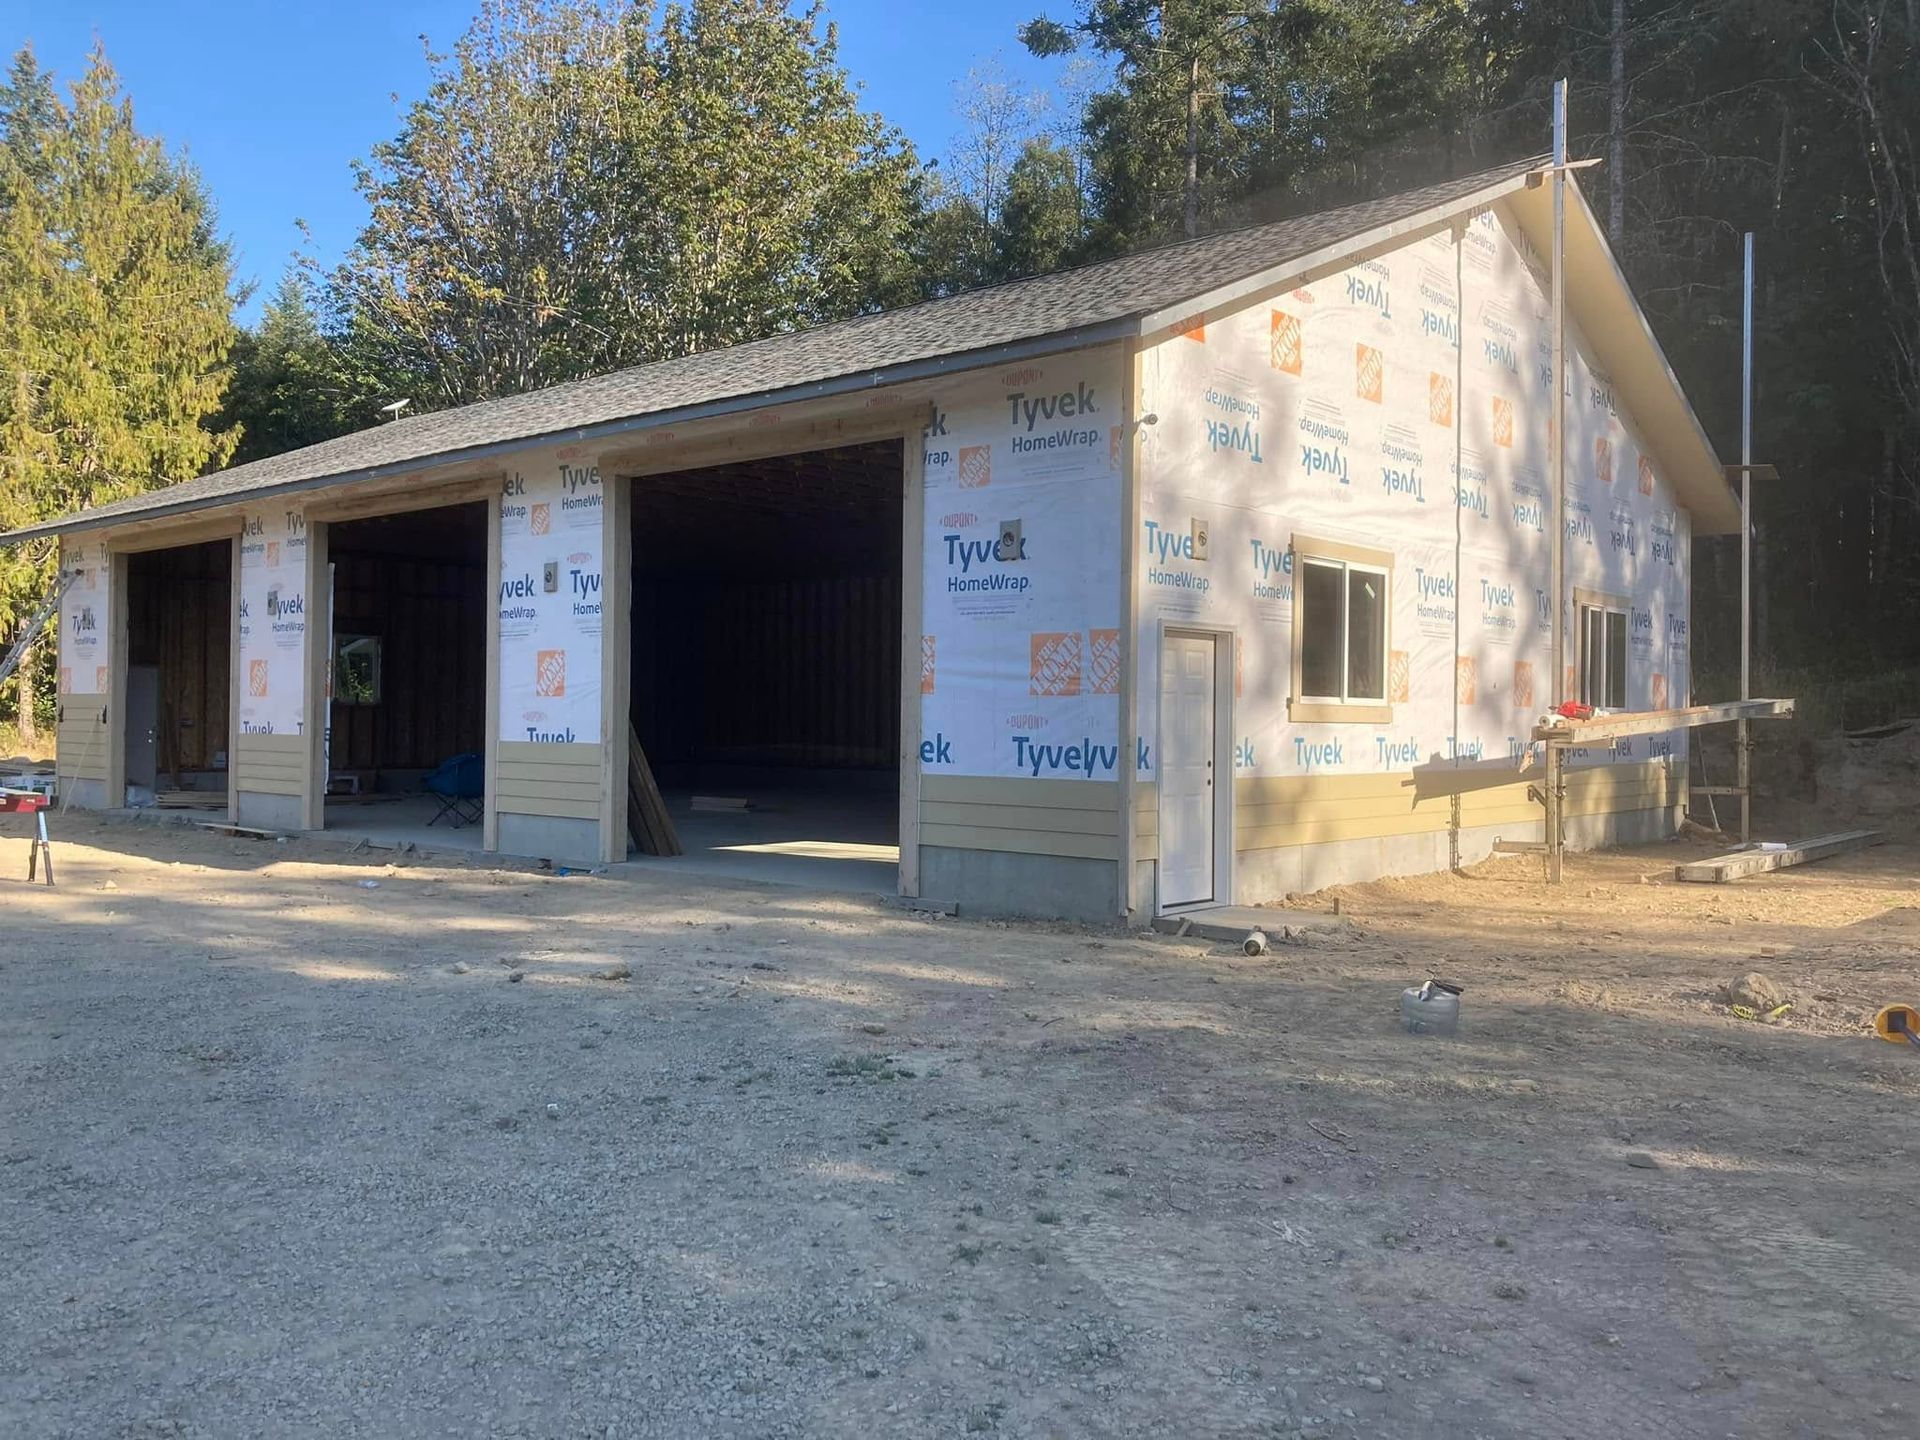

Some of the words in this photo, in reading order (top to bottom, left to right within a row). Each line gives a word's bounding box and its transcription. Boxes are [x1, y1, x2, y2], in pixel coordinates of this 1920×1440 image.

[1346, 275, 1391, 319] Tyvek
[1421, 308, 1459, 348] Tyvek
[1484, 339, 1518, 375] Tyvek
[1007, 381, 1095, 432] Tyvek
[1204, 386, 1260, 420] HomeWrap
[1206, 419, 1263, 463] Tyvek
[1299, 415, 1349, 446] HomeWrap
[1301, 445, 1350, 485] Tyvek
[1382, 466, 1425, 503] Tyvek
[1512, 503, 1544, 532] Tyvek
[1564, 515, 1592, 545] Tyvek
[1145, 520, 1192, 564] Tyve
[1610, 529, 1635, 556] Tyvek
[1651, 541, 1674, 566] Tyvek
[1251, 539, 1291, 579] Tyve
[1149, 567, 1208, 591] HomeWrap
[1415, 568, 1455, 601] Tyvek
[1481, 579, 1515, 610] Tyvek
[276, 594, 303, 620] yvek
[1631, 607, 1653, 633] Tyvek
[1295, 737, 1343, 772] Tyvek
[1376, 737, 1418, 770] Tyvek
[1446, 737, 1483, 768] Tyvek
